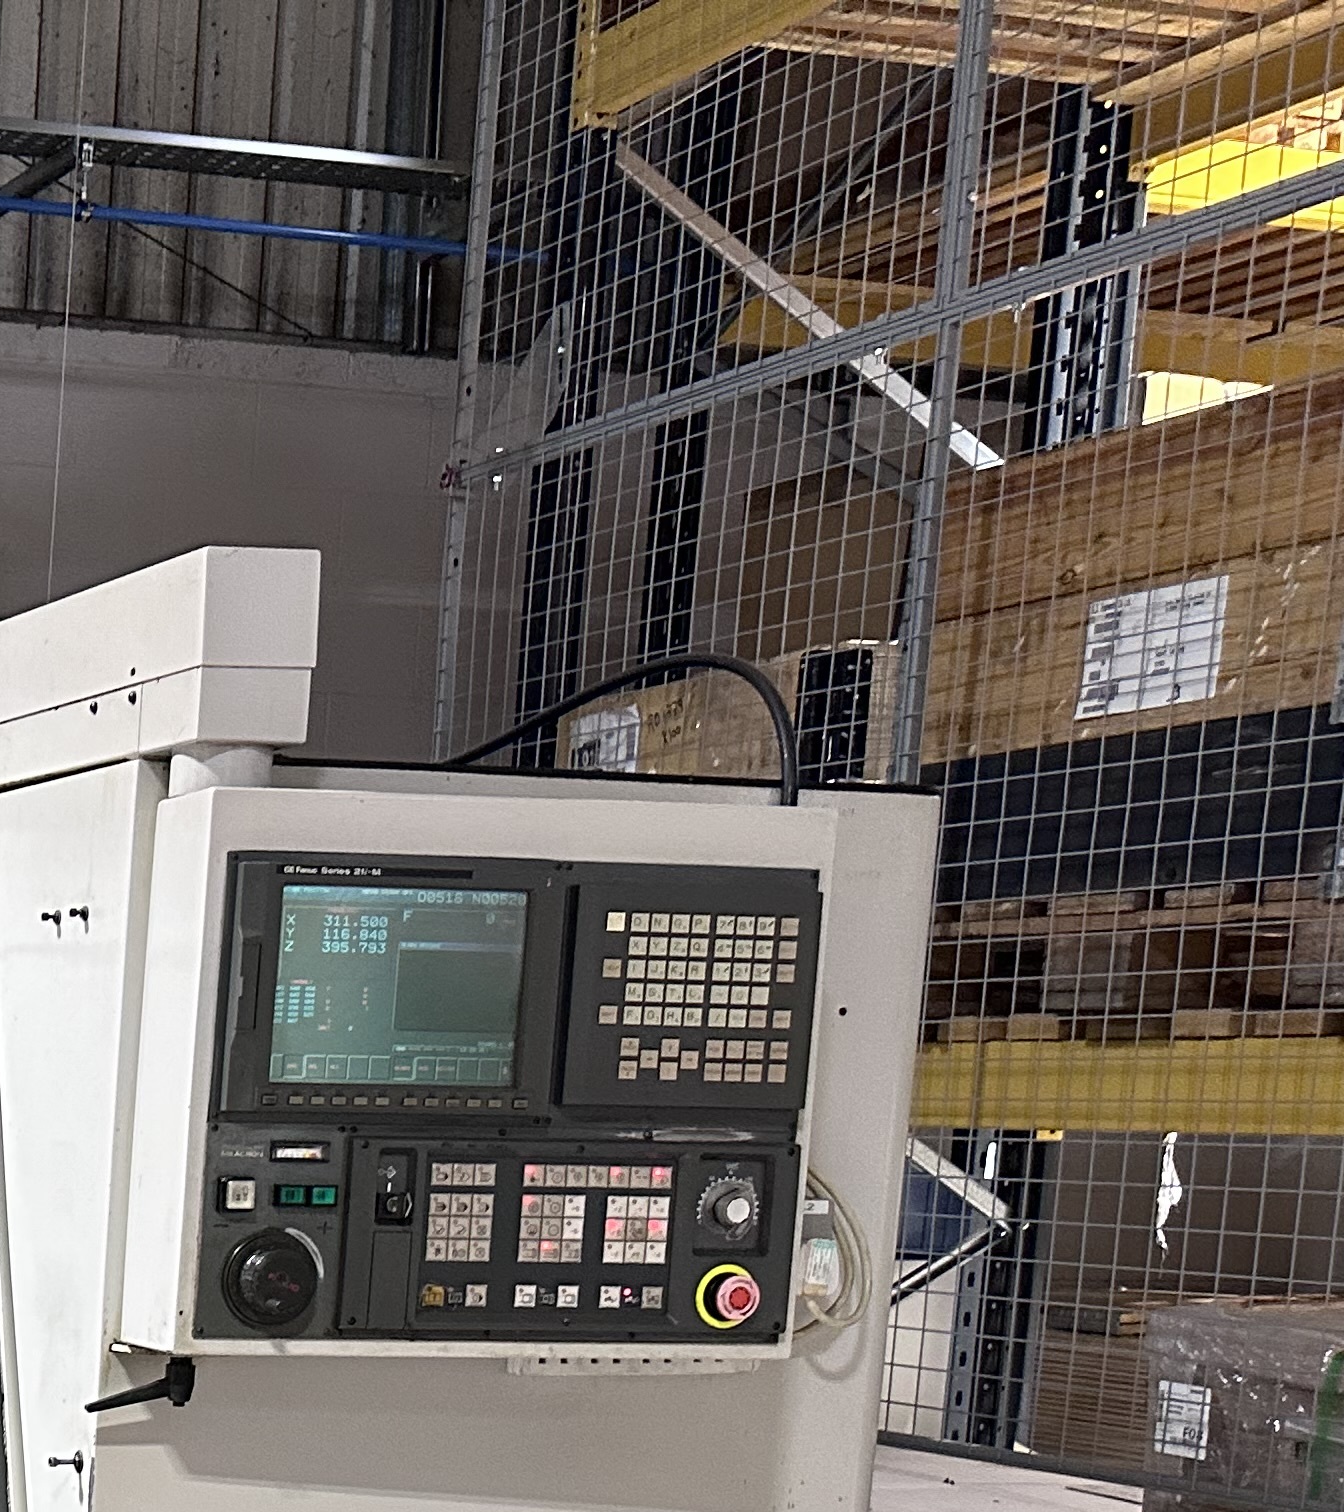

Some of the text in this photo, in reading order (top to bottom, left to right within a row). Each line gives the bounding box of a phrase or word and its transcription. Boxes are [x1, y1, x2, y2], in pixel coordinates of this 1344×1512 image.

[285, 913, 389, 928] X 311.500
[285, 927, 388, 941] Y 116.840
[283, 940, 295, 953] Z
[321, 941, 387, 954] 395.793
